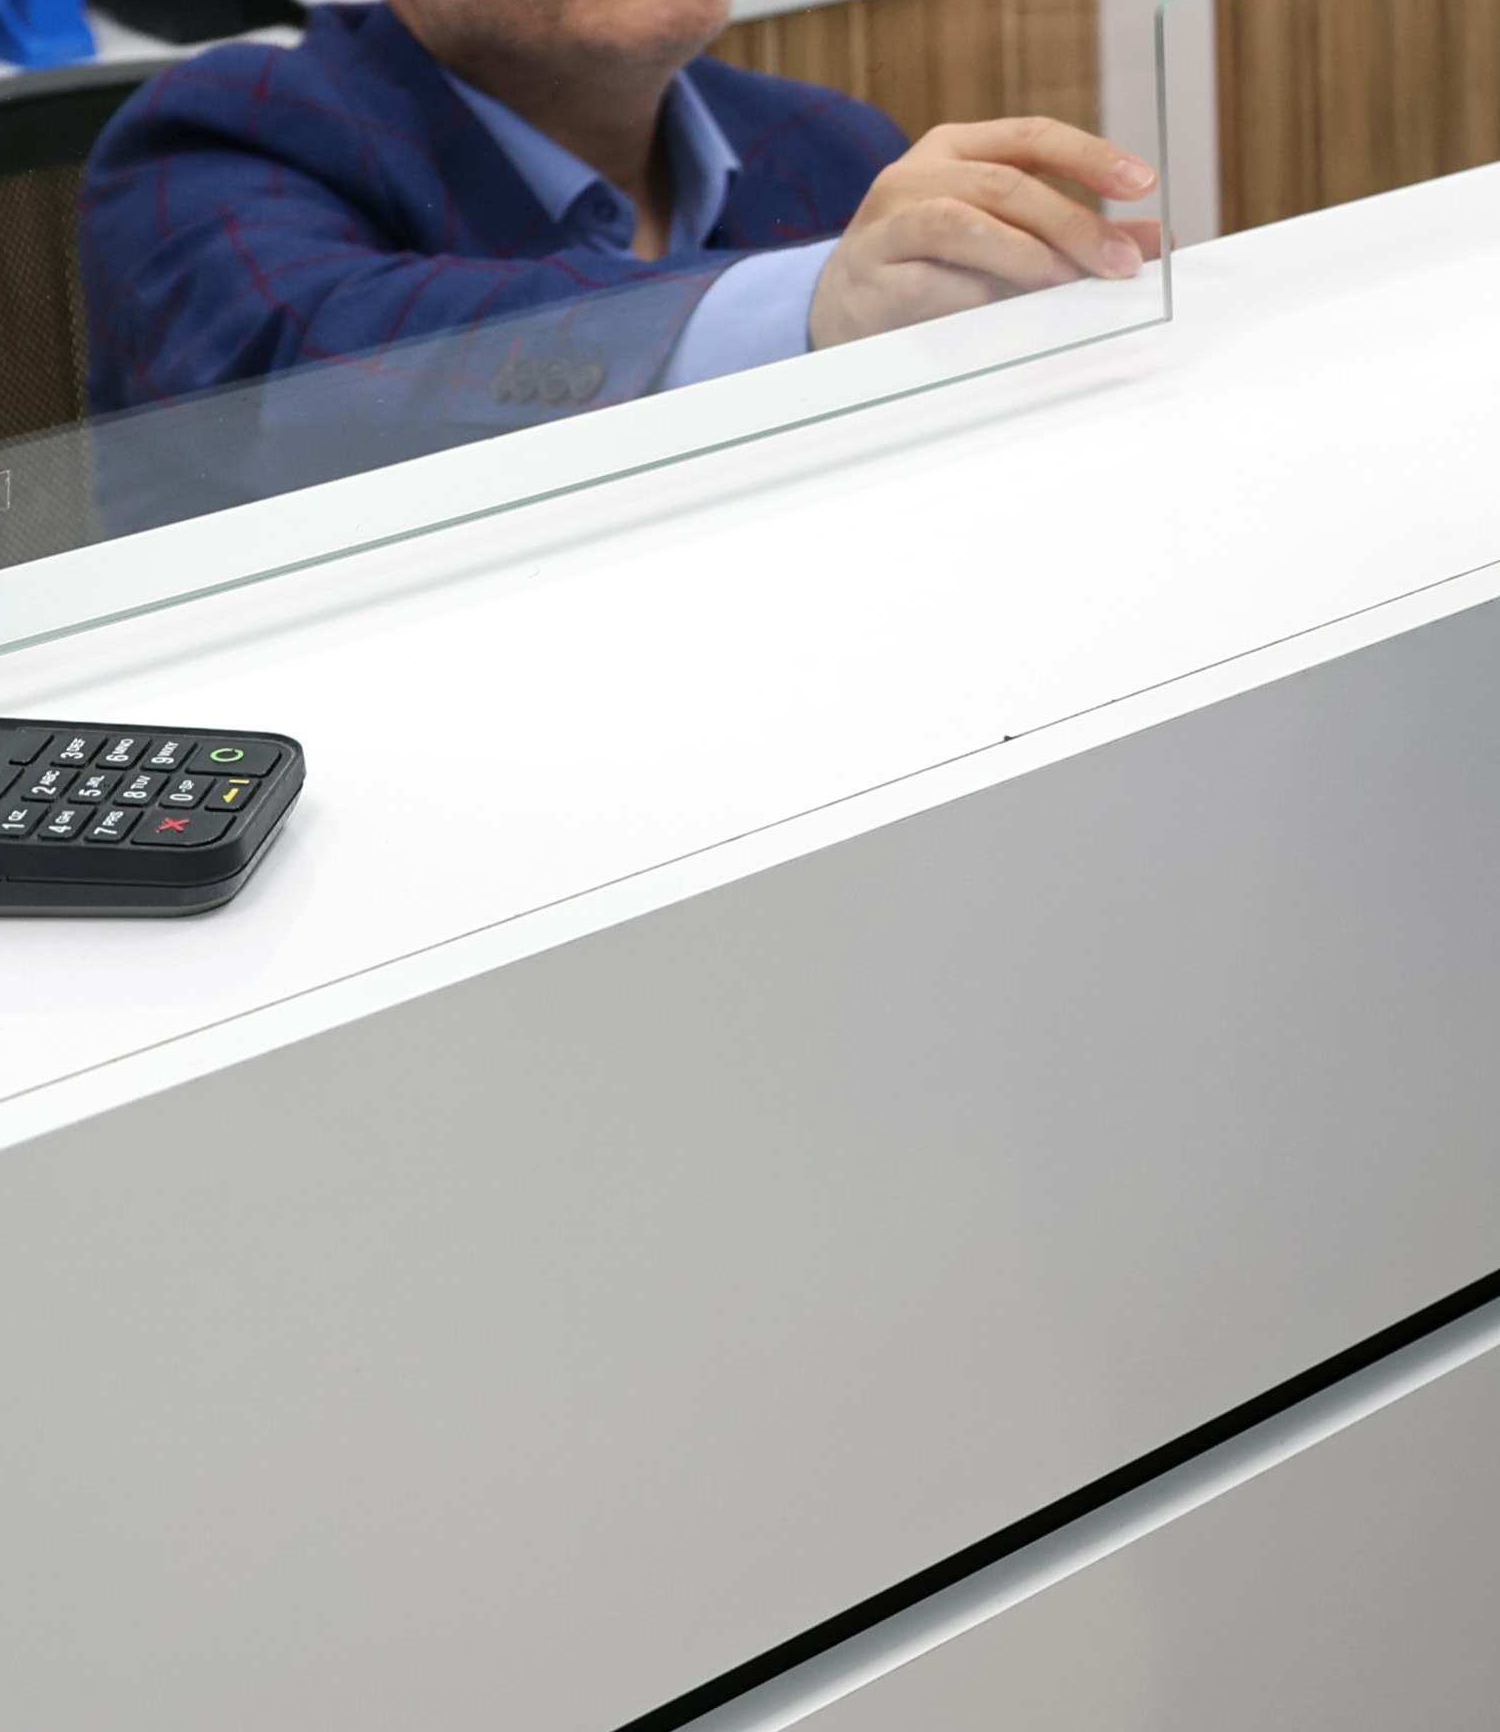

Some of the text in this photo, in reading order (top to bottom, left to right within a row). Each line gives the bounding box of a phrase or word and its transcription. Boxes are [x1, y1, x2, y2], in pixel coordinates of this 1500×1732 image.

[60, 751, 84, 760] 3
[105, 754, 129, 762] 6
[151, 756, 174, 764] 9
[31, 786, 56, 795] 2
[78, 788, 101, 797] 5
[123, 790, 148, 799] 8
[169, 793, 194, 801] 0
[48, 825, 72, 833] 4
[94, 826, 118, 835] 7
